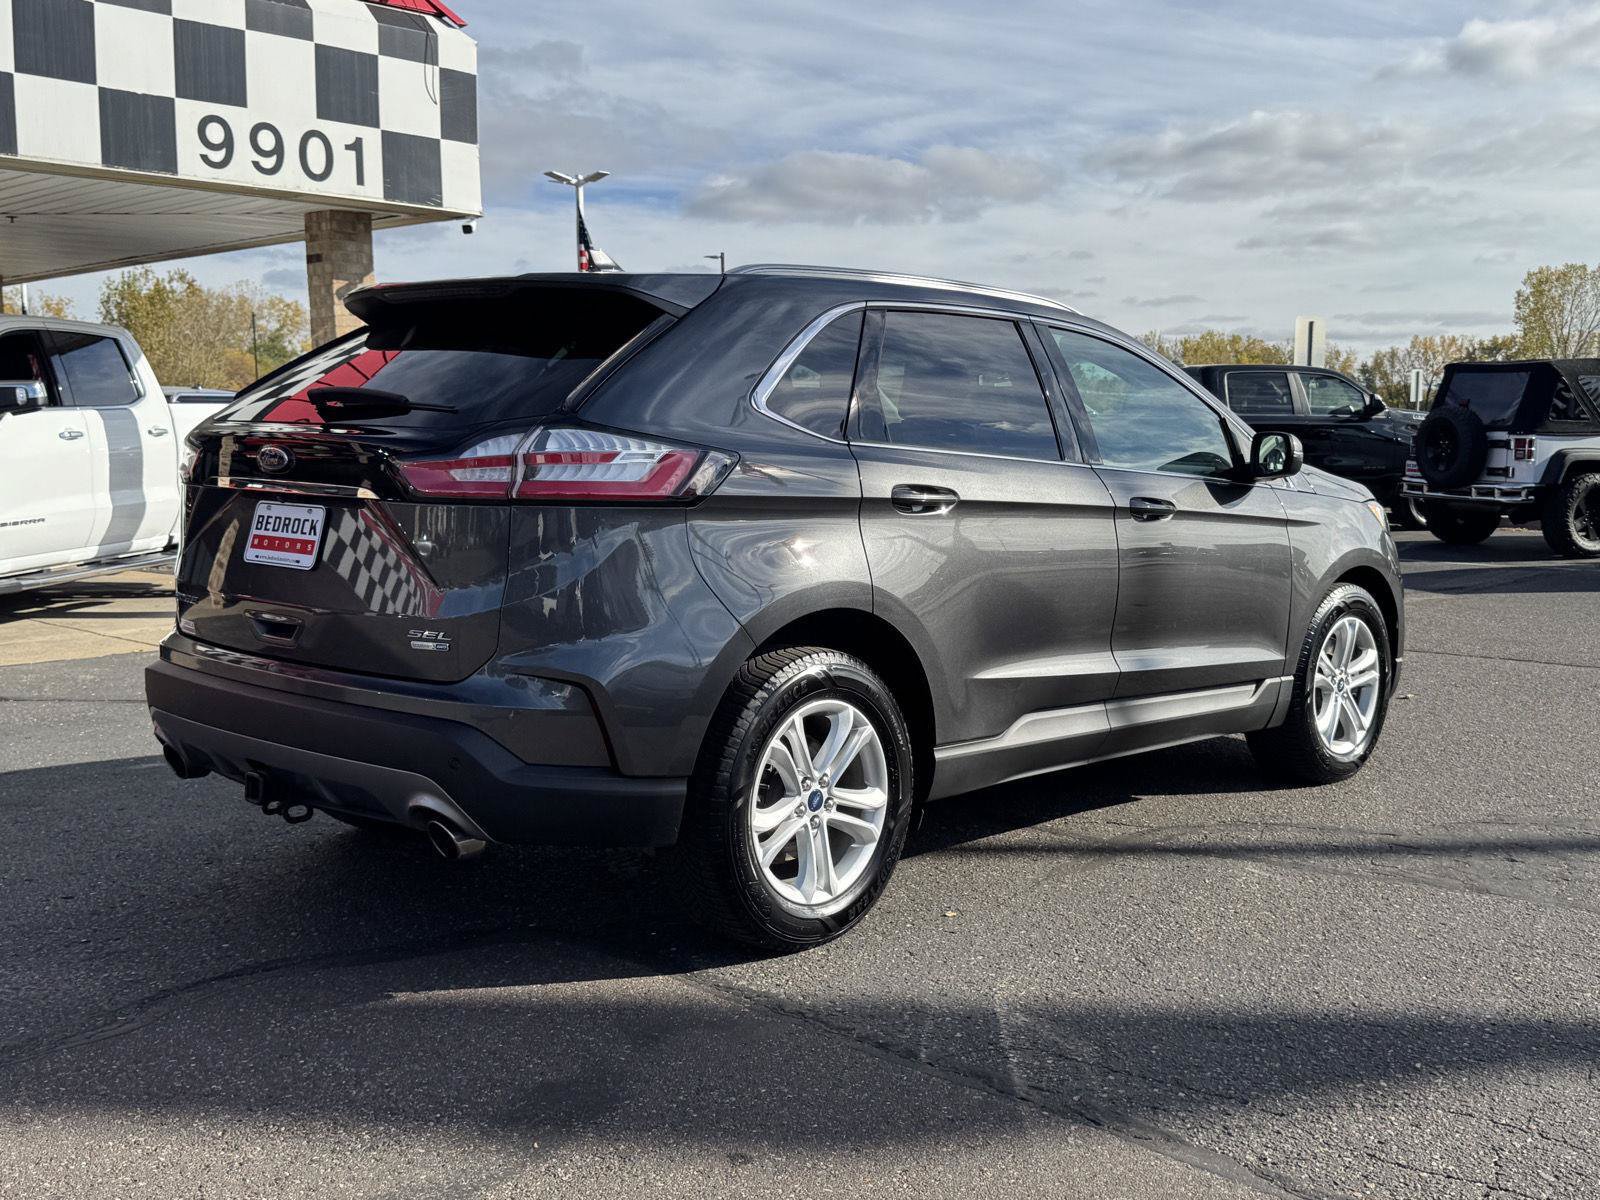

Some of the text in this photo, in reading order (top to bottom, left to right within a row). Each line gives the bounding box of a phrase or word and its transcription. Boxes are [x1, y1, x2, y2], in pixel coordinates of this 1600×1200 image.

[197, 114, 367, 187] 9901
[255, 515, 319, 536] BEDROCK
[253, 539, 313, 551] MOTORS
[407, 629, 452, 641] SEL
